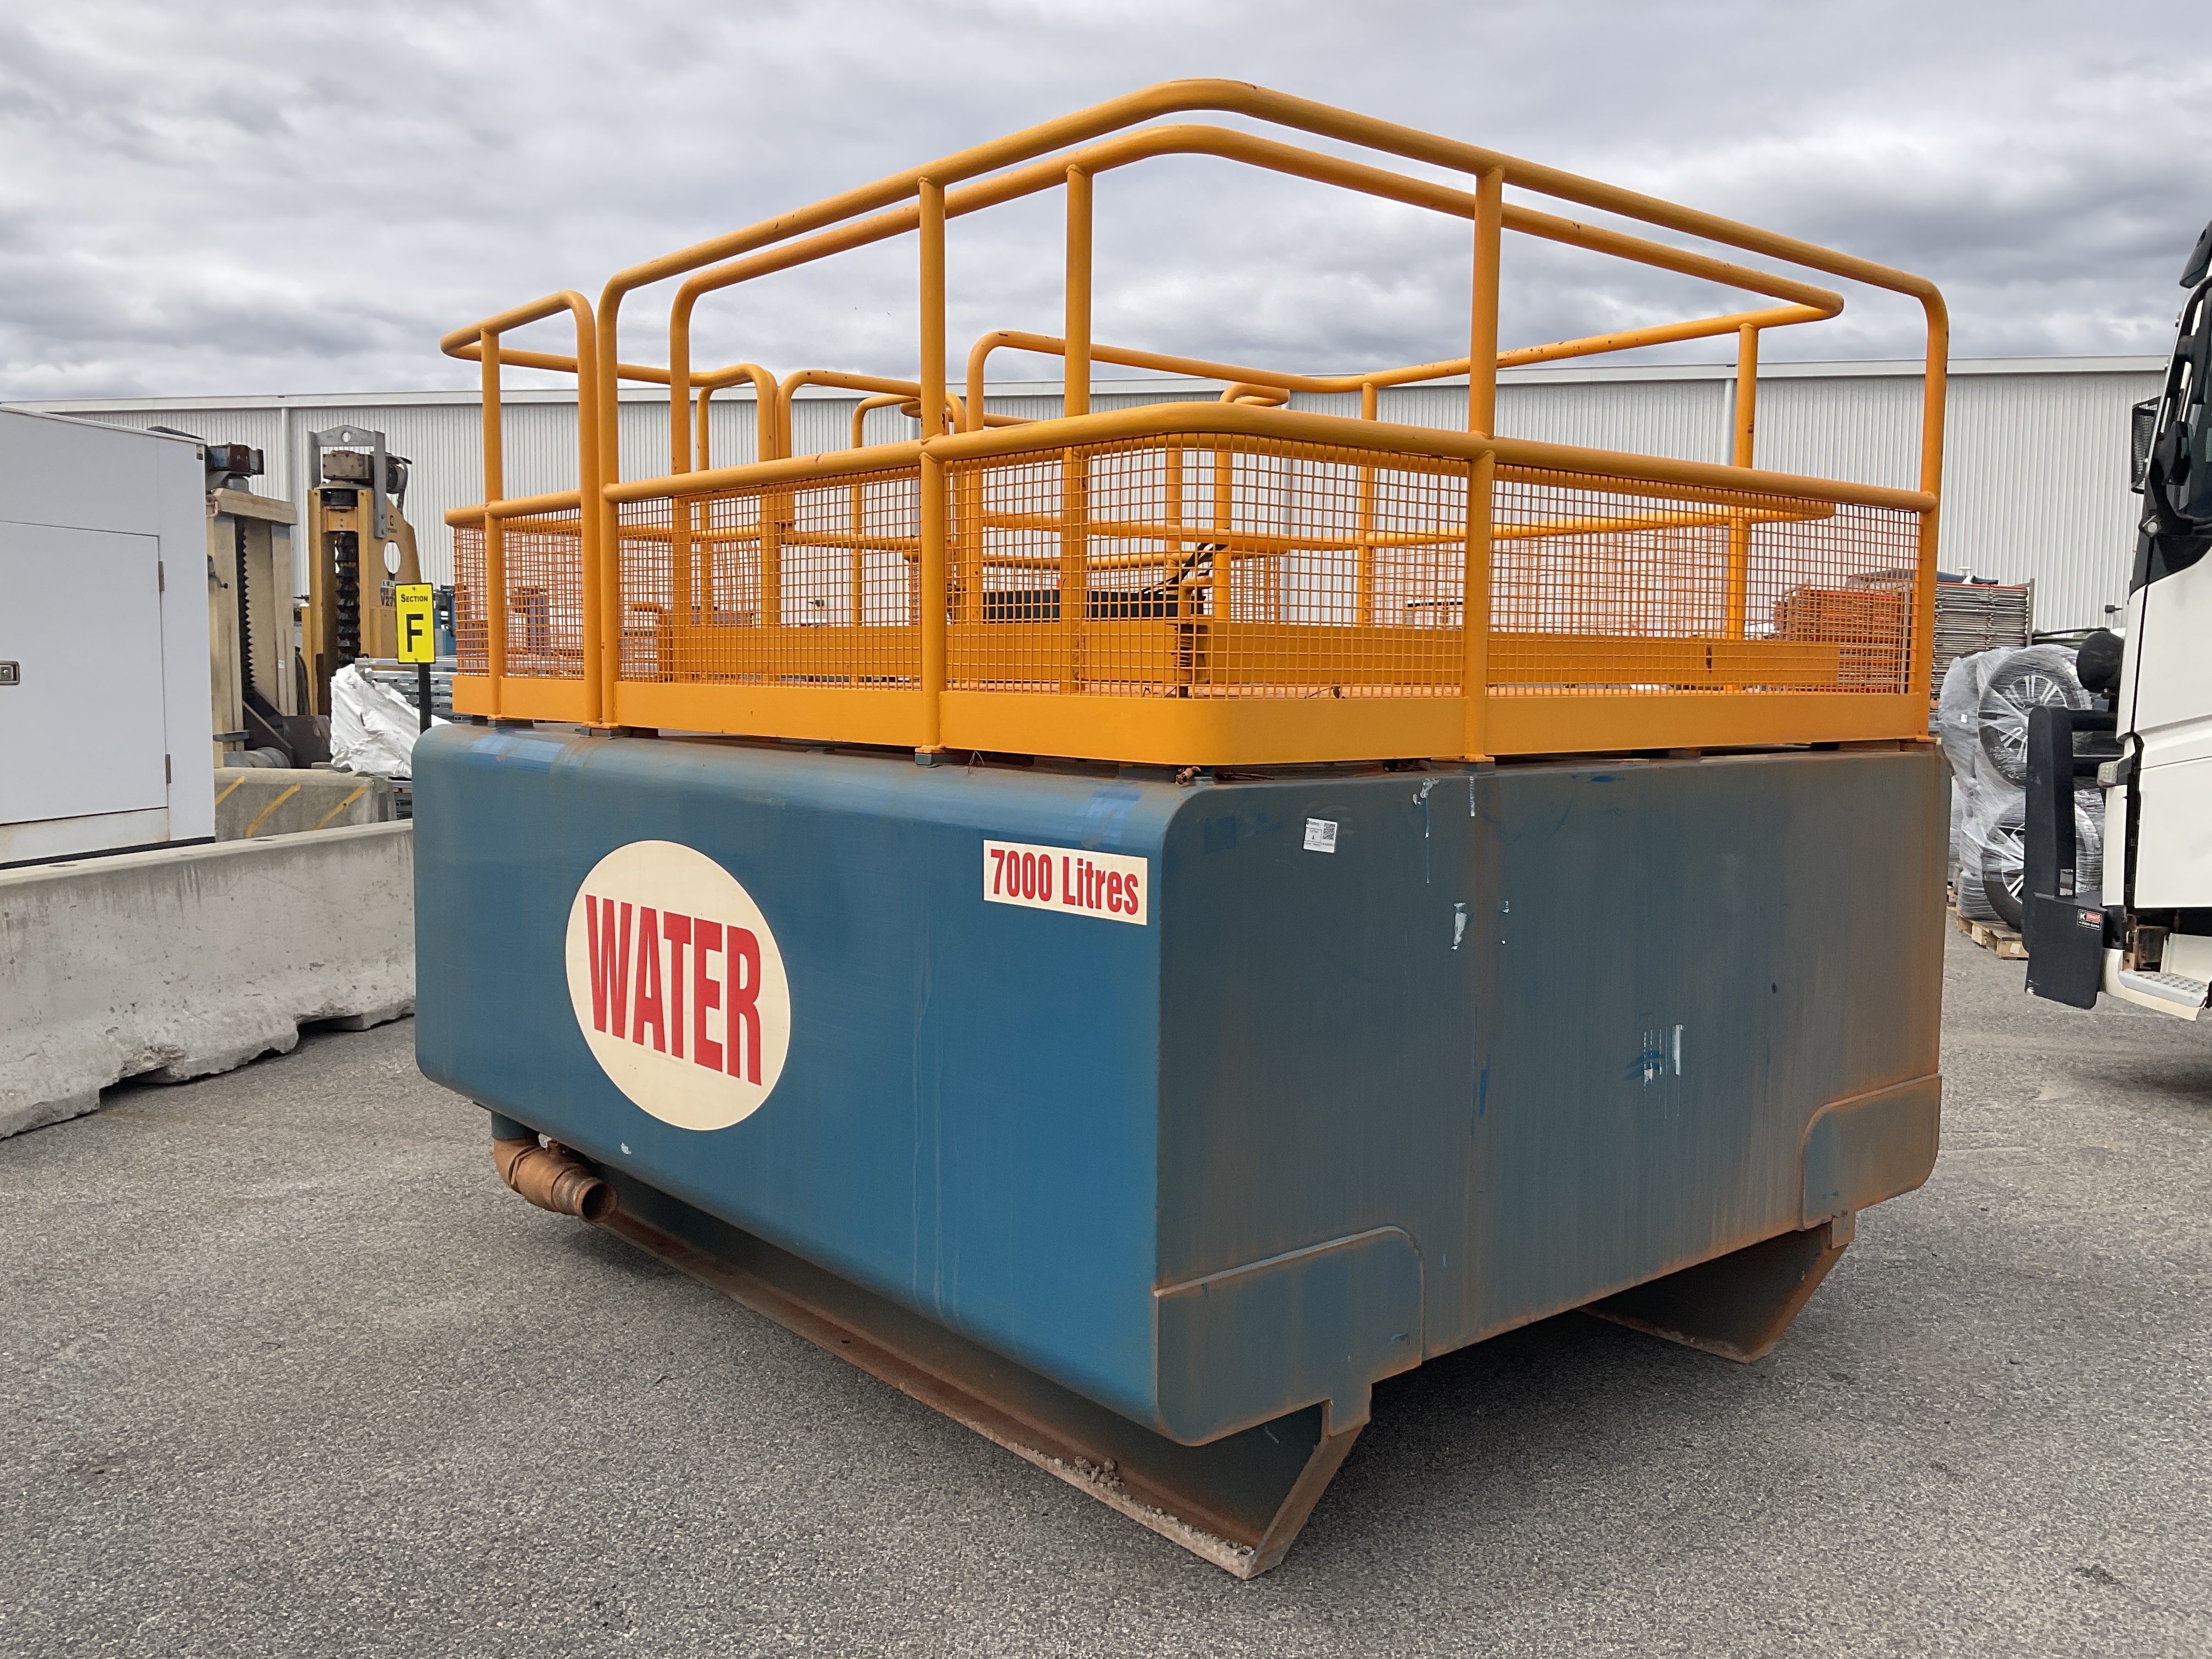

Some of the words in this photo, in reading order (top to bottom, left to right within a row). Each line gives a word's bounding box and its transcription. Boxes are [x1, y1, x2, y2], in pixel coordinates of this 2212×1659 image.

[407, 614, 424, 652] F
[991, 849, 1052, 901] 7000
[1063, 856, 1138, 915] Litres
[585, 894, 762, 1086] WATER
